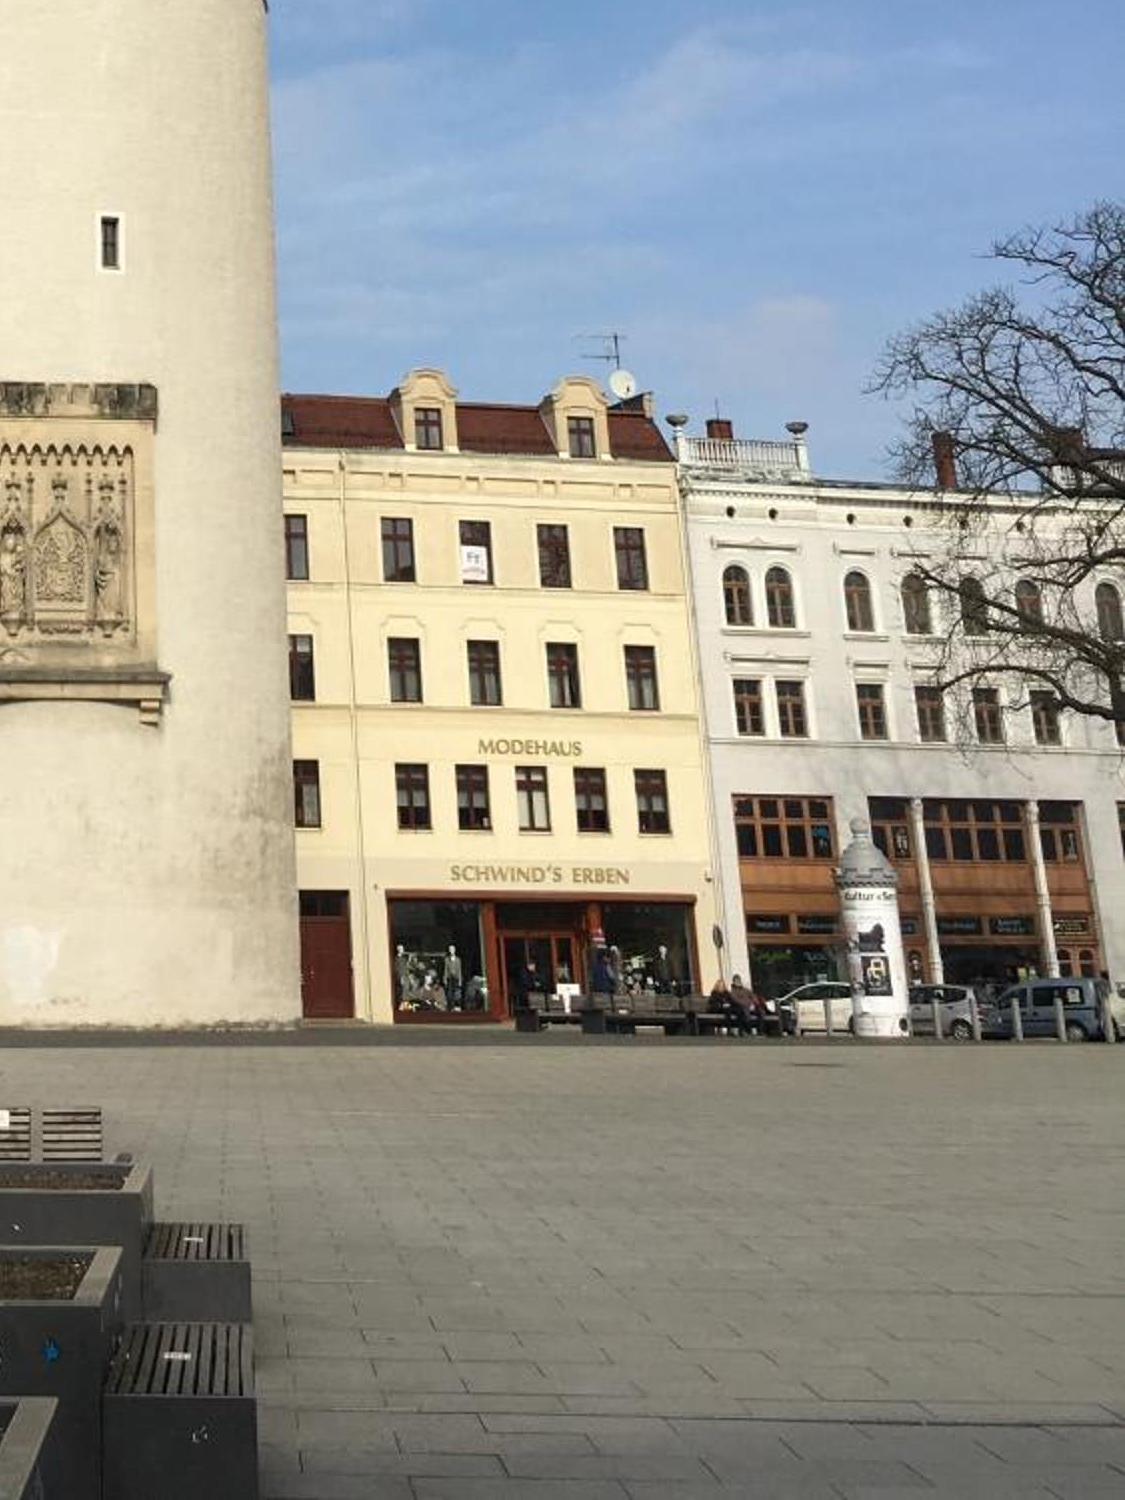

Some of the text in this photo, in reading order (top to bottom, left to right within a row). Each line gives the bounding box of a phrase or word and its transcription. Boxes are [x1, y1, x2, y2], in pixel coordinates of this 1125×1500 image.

[478, 739, 582, 757] MODEHAUS
[450, 864, 630, 885] SCHWIND'S ERBEN
